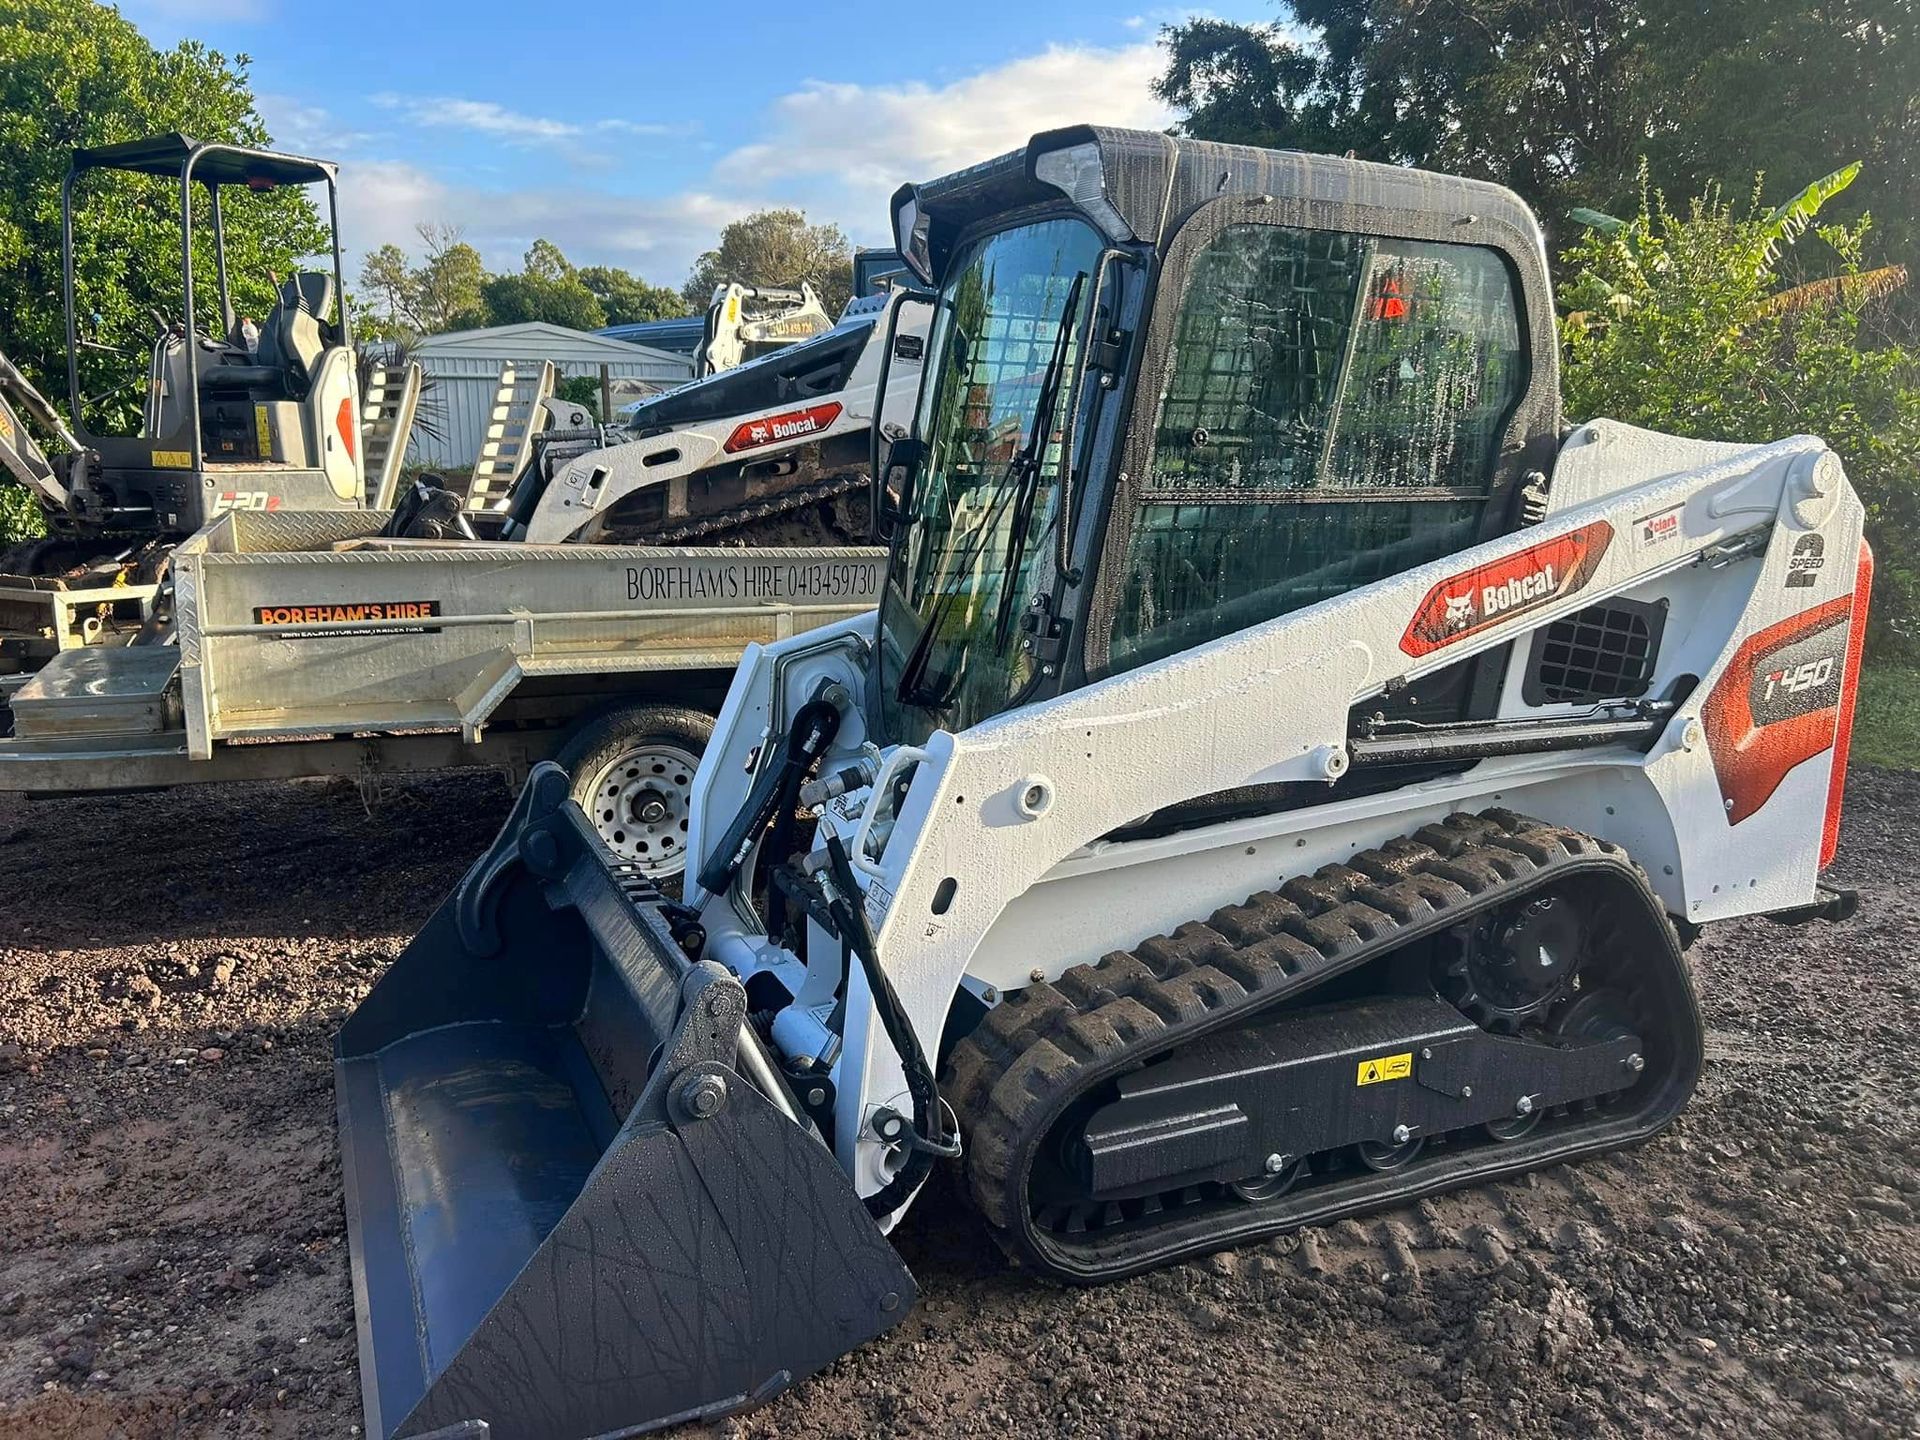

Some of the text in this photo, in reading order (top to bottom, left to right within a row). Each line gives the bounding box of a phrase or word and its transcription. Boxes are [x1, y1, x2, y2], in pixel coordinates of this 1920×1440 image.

[772, 416, 817, 439] Bobcat
[1654, 514, 1677, 533] clark
[1789, 557, 1825, 569] SPEED
[743, 565, 784, 598] HIRE
[788, 563, 877, 597] 0413459730
[1482, 563, 1555, 616] Bobcat
[261, 603, 432, 625] BOREHAM'S HIRE
